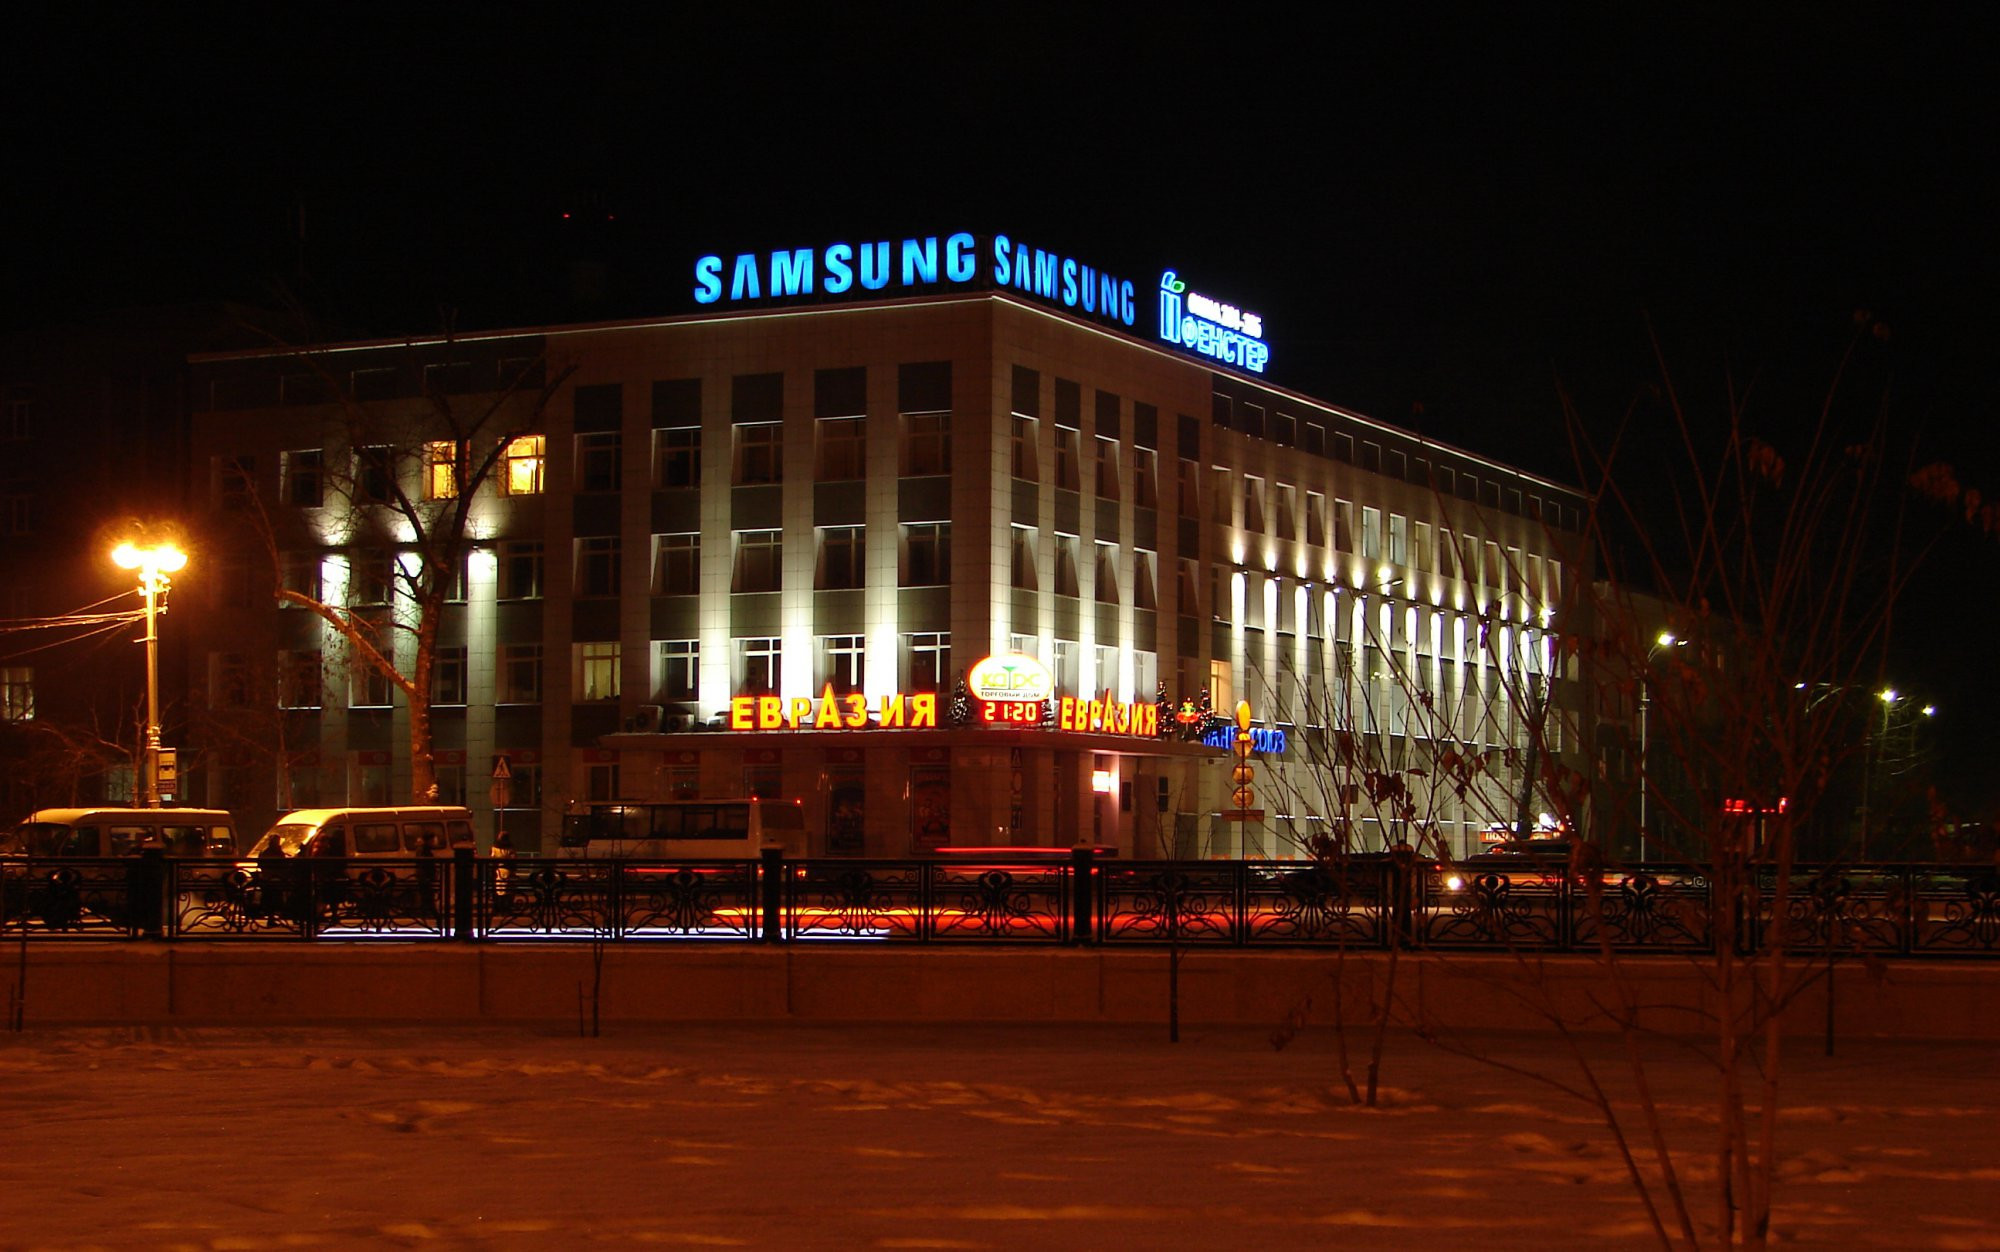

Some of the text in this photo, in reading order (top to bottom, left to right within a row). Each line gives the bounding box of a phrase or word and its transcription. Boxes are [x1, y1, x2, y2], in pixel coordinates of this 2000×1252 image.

[694, 232, 977, 306] SAMSUNG
[991, 234, 1136, 327] SAMSUNG
[1181, 316, 1269, 373] ФЕНСТЕР
[730, 684, 938, 731] ЕВРАЗИЯ
[984, 701, 1037, 721] 21:20
[1059, 688, 1159, 737] ЕВРАЗИЯ
